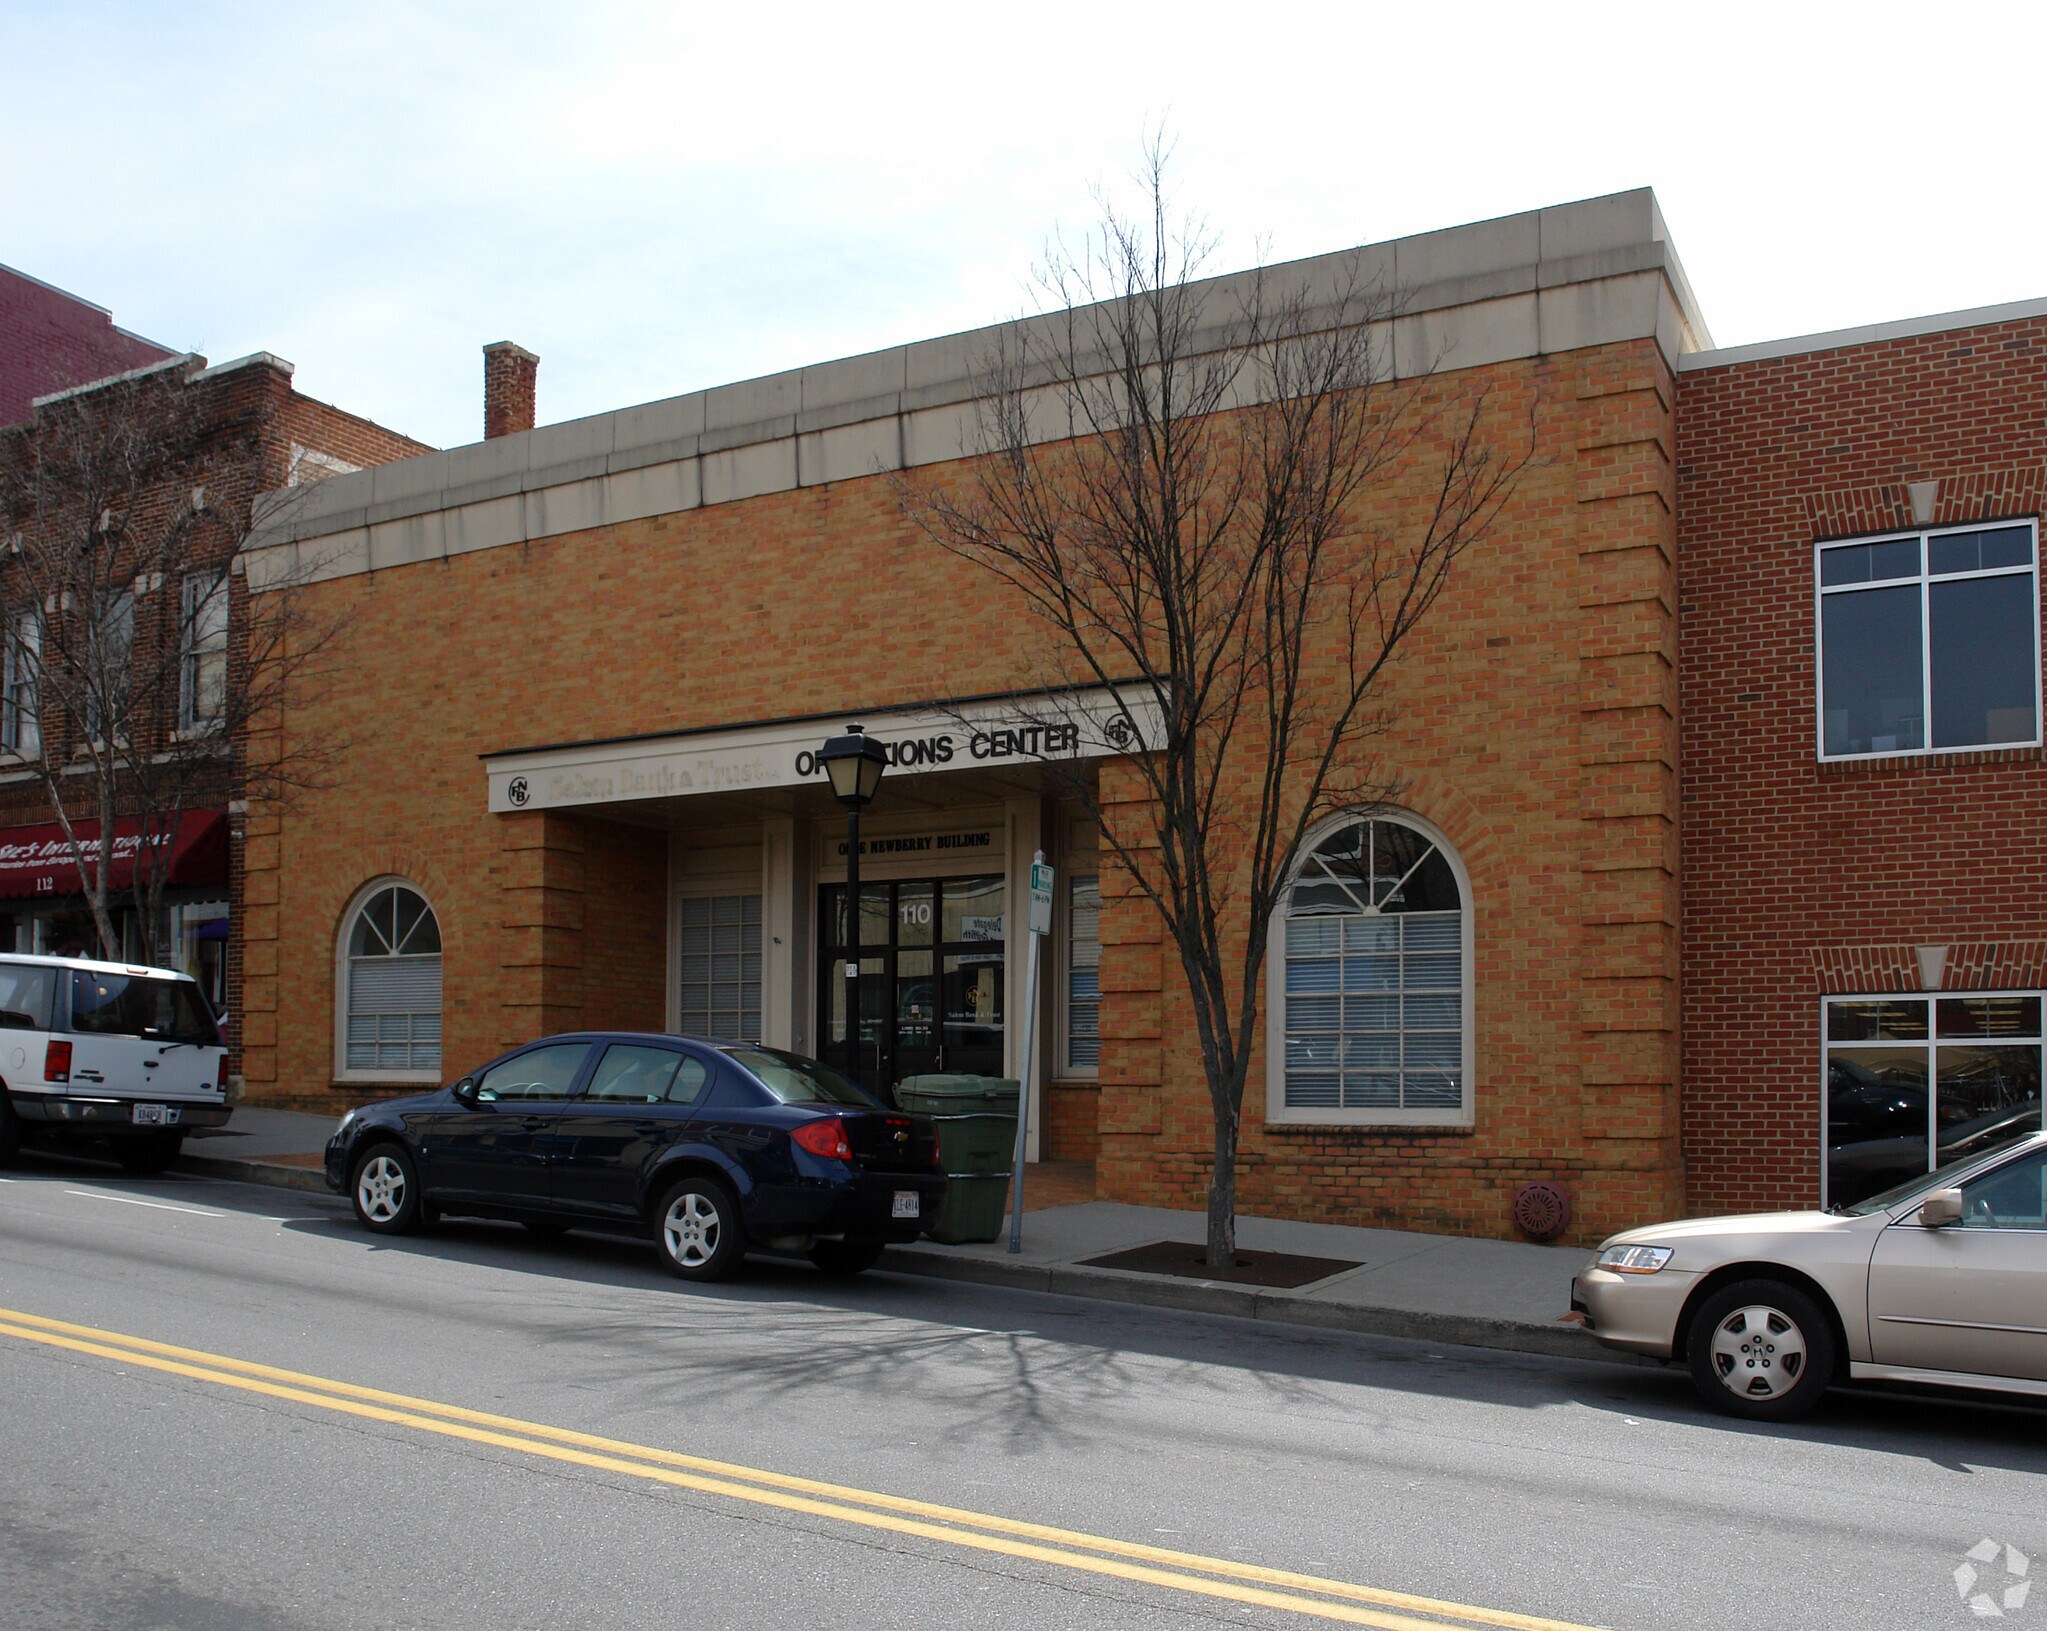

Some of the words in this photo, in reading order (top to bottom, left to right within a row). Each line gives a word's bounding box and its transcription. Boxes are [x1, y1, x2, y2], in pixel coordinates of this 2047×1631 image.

[970, 723, 1079, 759] CENTER
[870, 837, 932, 854] NEWBERRY
[937, 832, 990, 848] BUILDING
[36, 876, 53, 891] 112
[900, 904, 931, 924] 110
